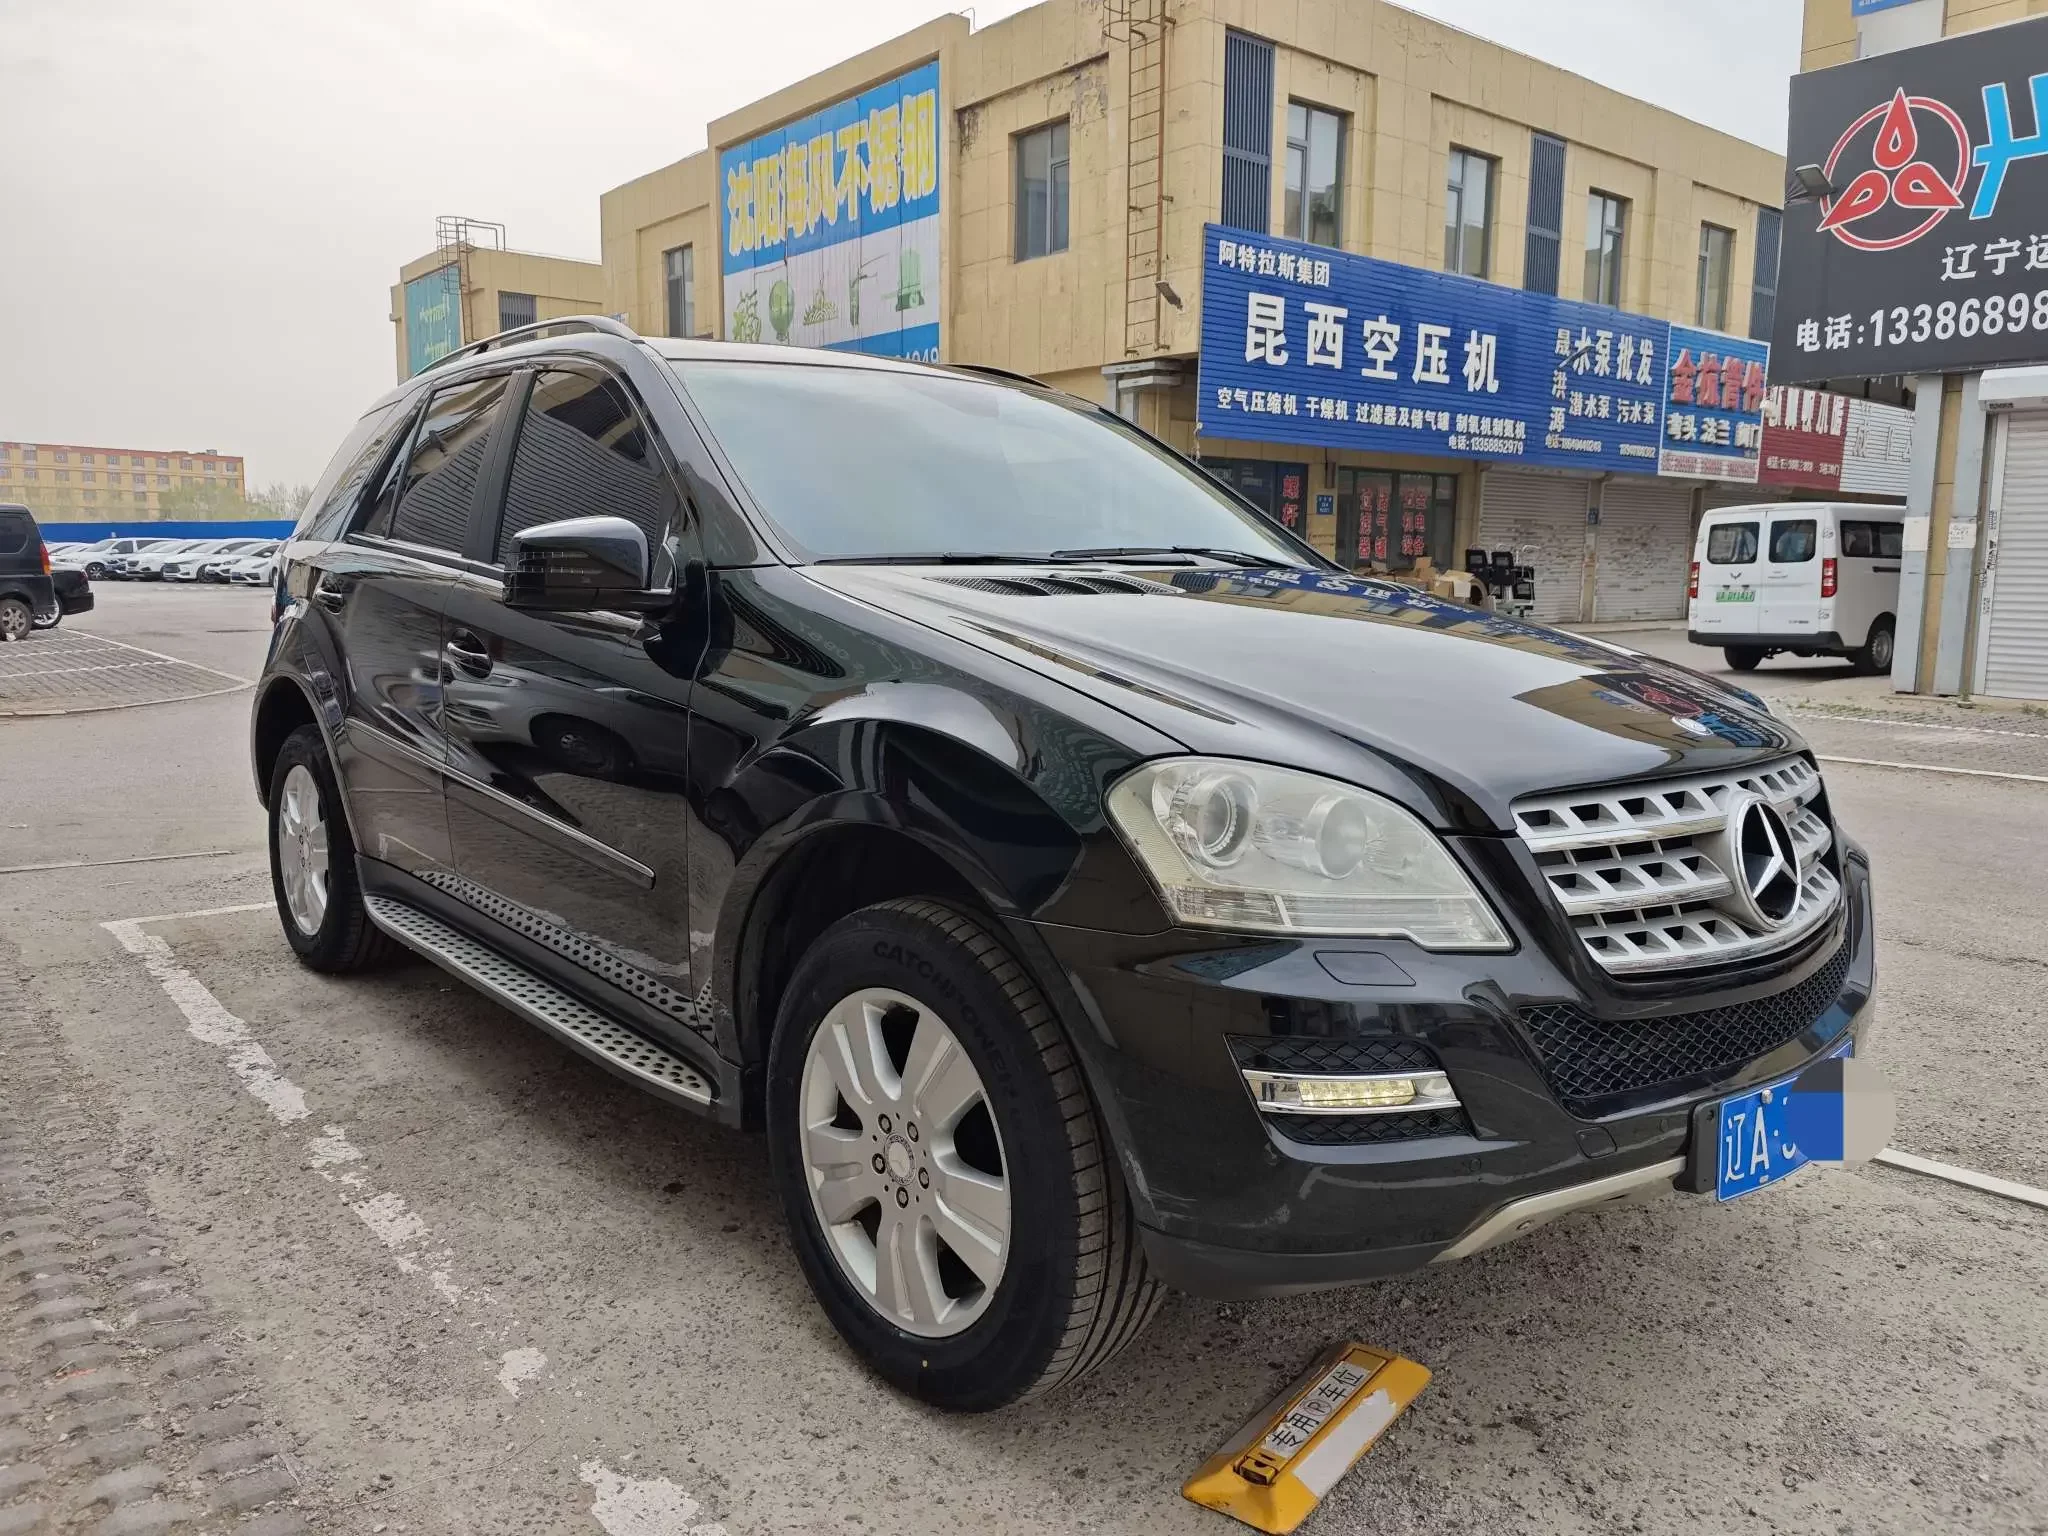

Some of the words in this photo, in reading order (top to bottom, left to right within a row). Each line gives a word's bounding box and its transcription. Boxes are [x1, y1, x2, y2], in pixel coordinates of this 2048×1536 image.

[1218, 239, 1330, 288] 阿特拉斯集团
[1245, 291, 1499, 394] 昆西空压机
[1572, 326, 1653, 386] 水泵批发
[1216, 387, 1298, 416] 空气压缩机
[1305, 396, 1349, 421] 干燥机
[1355, 401, 1449, 432] 过滤器及储气罐
[1569, 391, 1610, 419] 潜水泵
[1616, 397, 1655, 425] 污水泵
